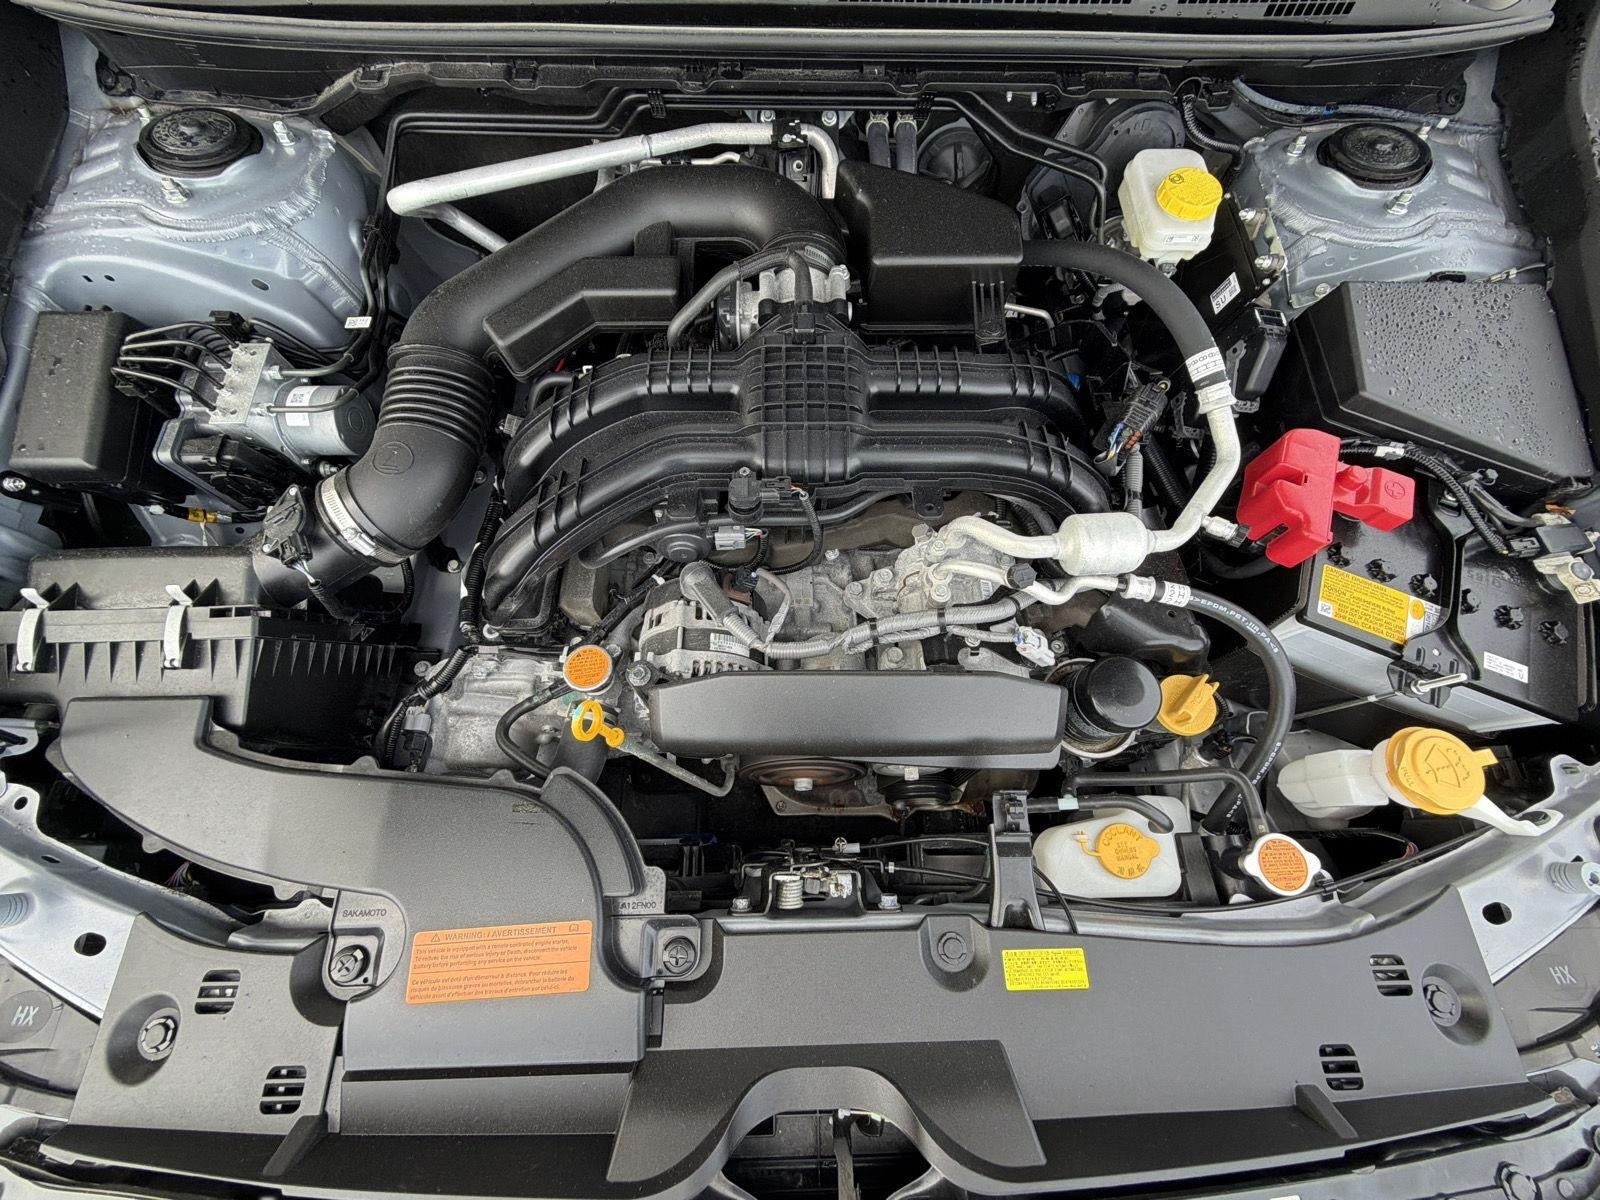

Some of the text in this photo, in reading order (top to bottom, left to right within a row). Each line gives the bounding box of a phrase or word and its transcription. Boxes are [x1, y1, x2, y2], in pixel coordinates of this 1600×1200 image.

[342, 908, 388, 918] SAKAMOTO
[491, 926, 556, 937] AVERTISSEMENT
[1549, 964, 1577, 985] HX
[11, 1005, 40, 1027] HX
